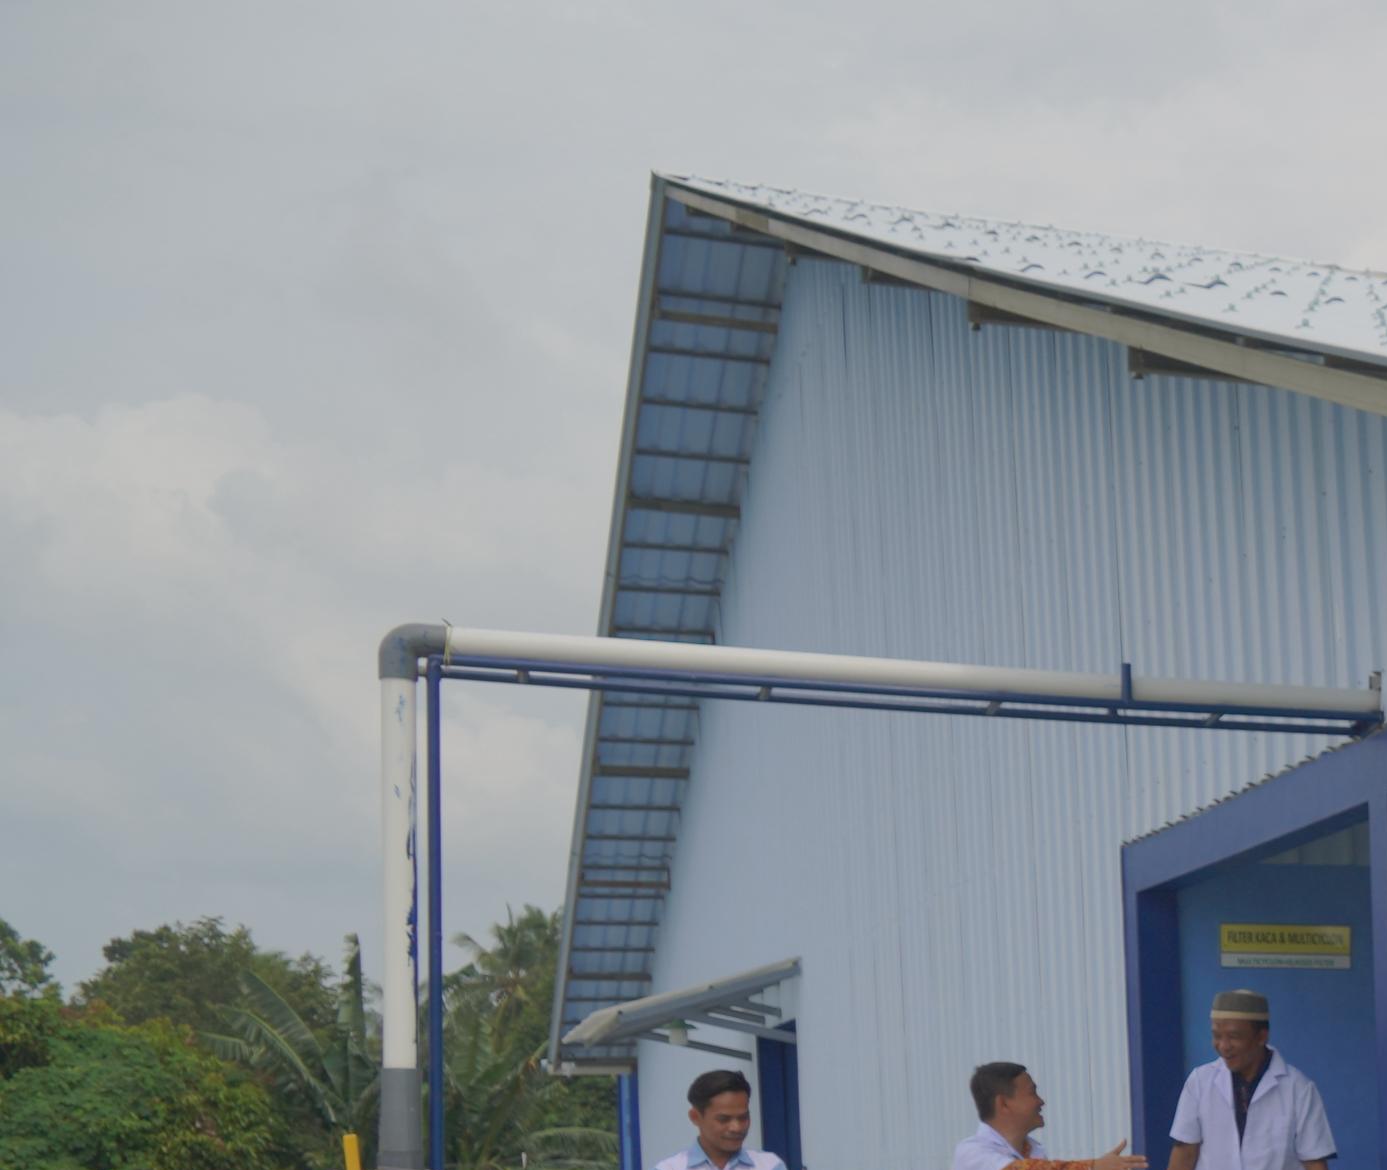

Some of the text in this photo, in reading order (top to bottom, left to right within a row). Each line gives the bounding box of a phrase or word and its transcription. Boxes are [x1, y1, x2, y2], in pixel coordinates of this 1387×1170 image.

[1227, 931, 1253, 944] FILTER
[1255, 931, 1278, 945] KACA
[1278, 931, 1286, 945] &
